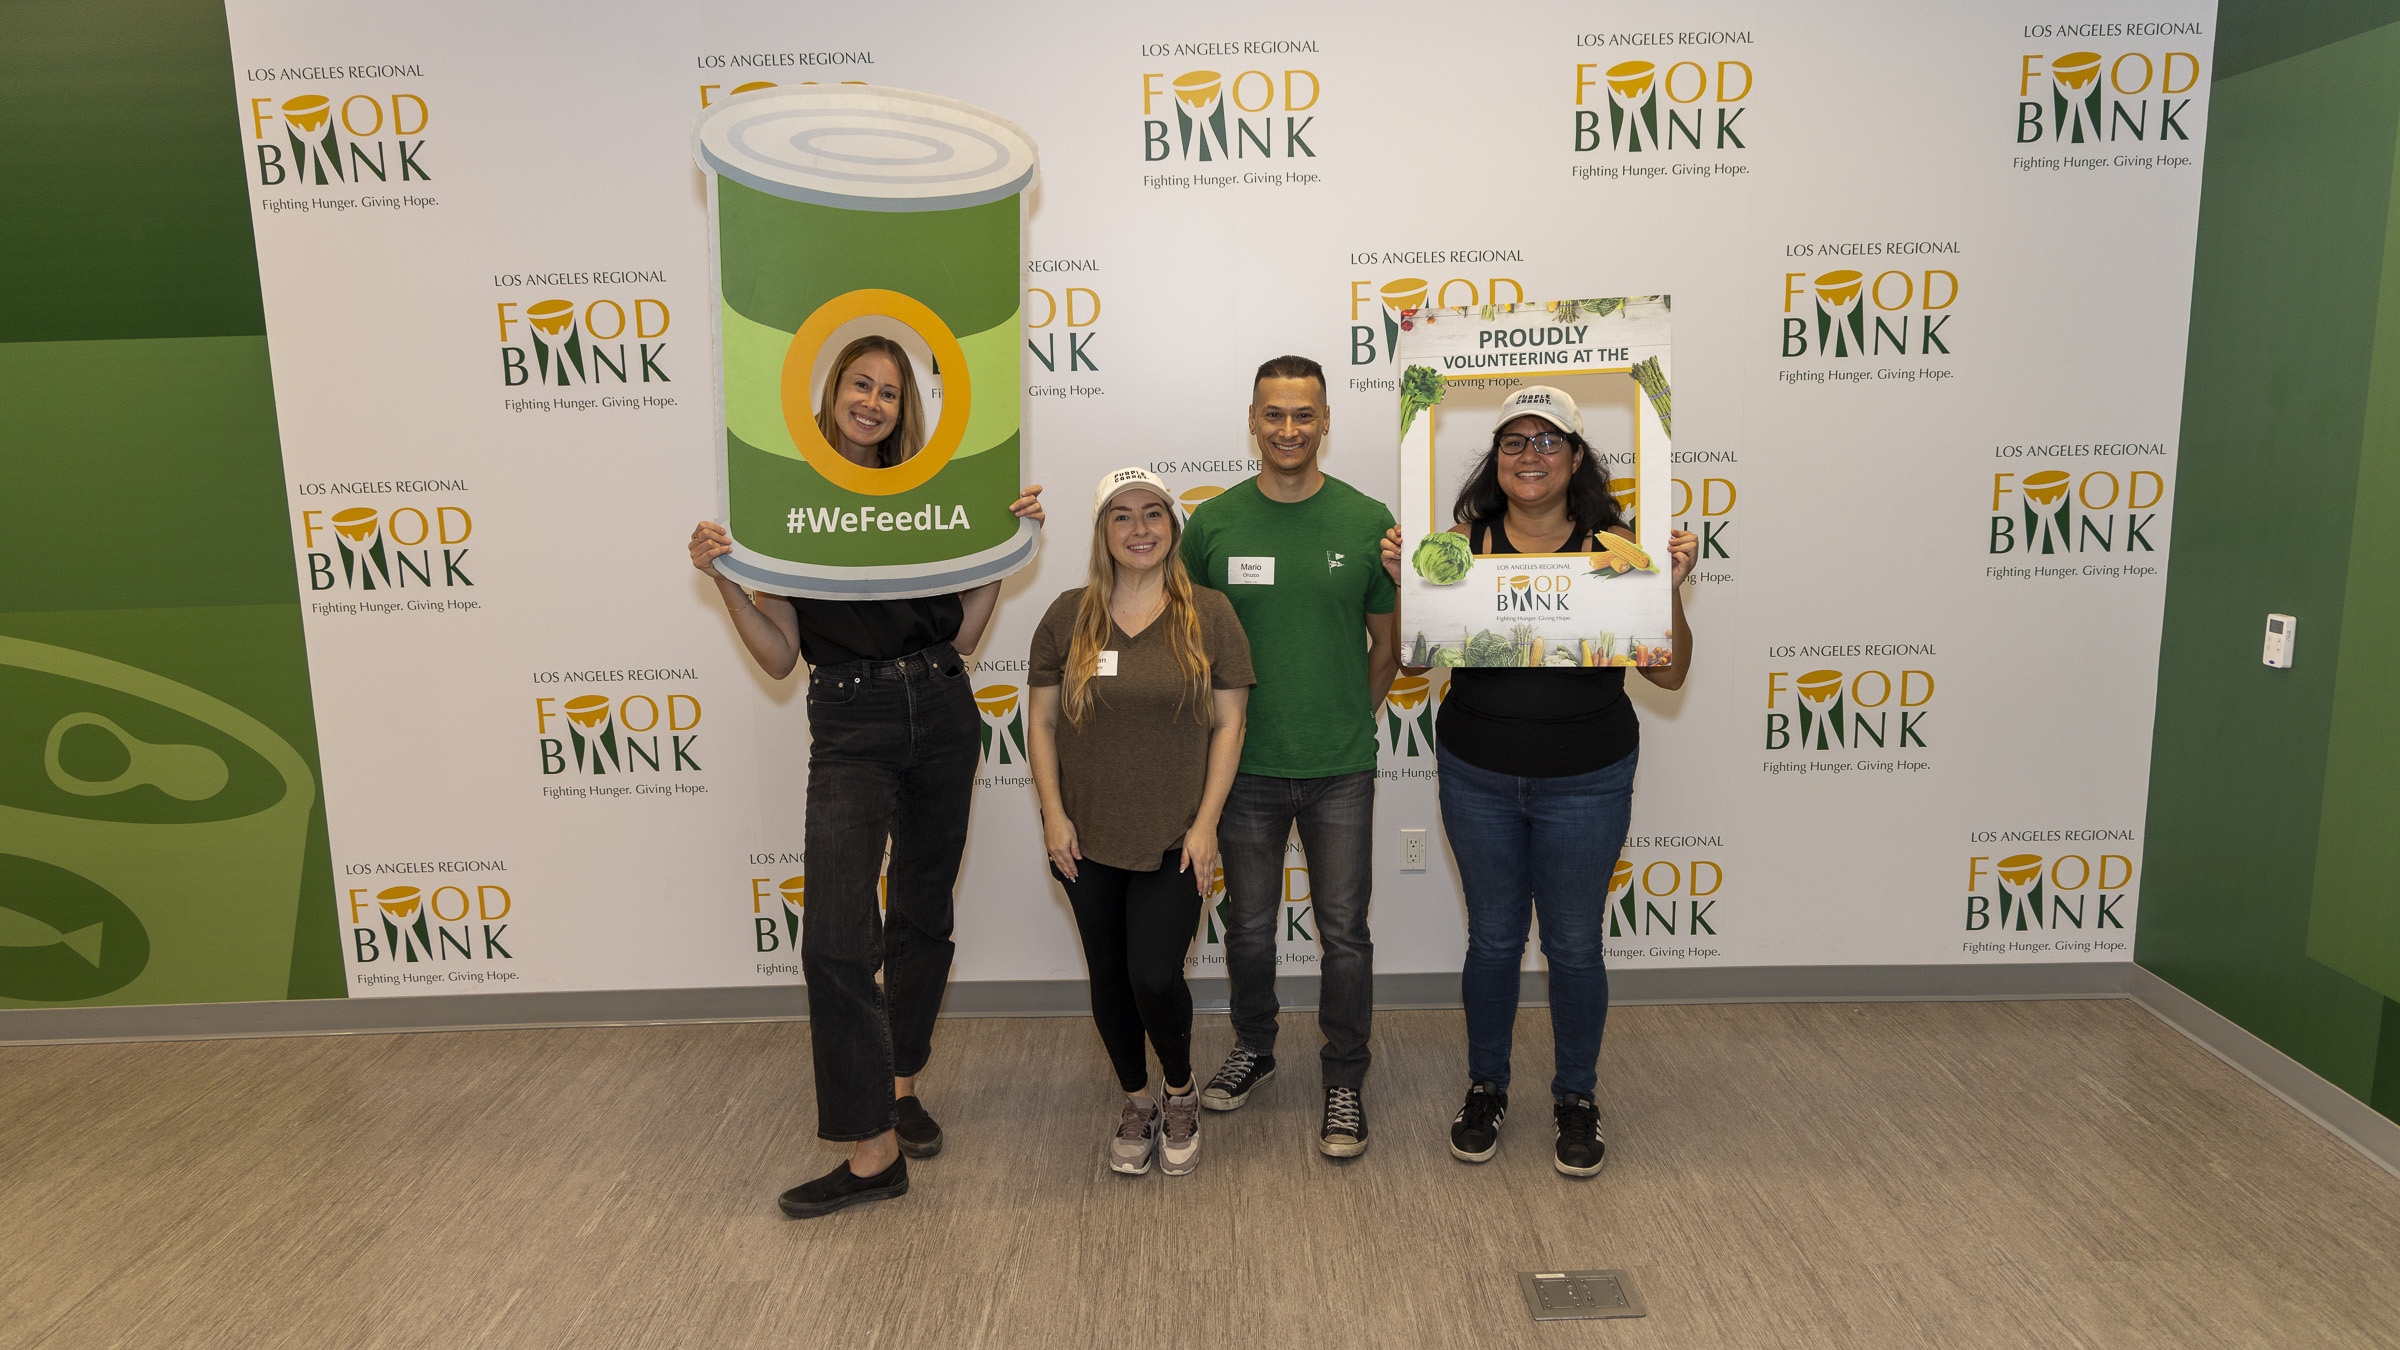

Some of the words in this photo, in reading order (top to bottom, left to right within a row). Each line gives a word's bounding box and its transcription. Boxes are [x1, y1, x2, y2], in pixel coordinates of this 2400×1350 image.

[2024, 24, 2052, 38] LOS
[2056, 23, 2122, 37] ANGELES
[2126, 22, 2202, 36] REGIONAL
[1577, 34, 1605, 47] LOS
[1608, 32, 1674, 46] ANGELES
[1678, 31, 1754, 45] REGIONAL
[1142, 44, 1170, 56] LOS
[1174, 42, 1239, 56] ANGELES
[1244, 40, 1319, 54] REGIONAL
[698, 55, 726, 68] LOS
[730, 53, 795, 67] ANGELES
[799, 51, 875, 65] REGIONAL
[248, 68, 276, 82] LOS
[280, 66, 344, 80] ANGELES
[348, 64, 424, 78] REGIONAL
[2013, 156, 2060, 172] Fighting
[2064, 156, 2109, 170] Hunger.
[2114, 155, 2153, 170] Giving
[2156, 154, 2192, 169] Hope.
[1572, 165, 1618, 180] Fighting
[1622, 165, 1668, 179] Hunger.
[1672, 163, 1711, 178] Giving
[1714, 163, 1750, 177] Hope.
[1144, 174, 1190, 190] Fighting
[1194, 174, 1239, 188] Hunger.
[1243, 172, 1282, 186] Giving
[1286, 172, 1321, 186] Hope.
[262, 198, 310, 214] Fighting
[312, 198, 358, 212] Hunger.
[361, 196, 401, 210] Giving
[403, 195, 439, 209] Hope.
[1351, 253, 1377, 265] LOS
[1382, 251, 1446, 265] ANGELES
[1450, 249, 1524, 263] REGIONAL
[1786, 244, 1814, 257] LOS
[1818, 242, 1882, 256] ANGELES
[1886, 242, 1960, 254] REGIONAL
[494, 274, 522, 287] LOS
[526, 272, 589, 286] ANGELES
[593, 270, 667, 284] REGIONAL
[1479, 325, 1589, 349] PROUDLY
[1443, 351, 1568, 370] VOLUNTEERING
[1573, 349, 1594, 363] AT
[1597, 347, 1629, 362] THE
[1779, 370, 1825, 384] Fighting
[1828, 370, 1873, 384] Hunger.
[1877, 368, 1916, 382] Giving
[1919, 368, 1954, 382] Hope.
[1029, 385, 1067, 399] Giving
[1070, 385, 1104, 399] Hope.
[1349, 377, 1395, 393] Fighting
[1447, 378, 1485, 392] Giving
[1489, 378, 1523, 391] Hope.
[505, 398, 551, 413] Fighting
[553, 398, 598, 412] Hunger.
[602, 396, 640, 410] Giving
[643, 396, 678, 409] Hope.
[1996, 445, 2022, 458] LOS
[2026, 444, 2090, 457] ANGELES
[2094, 444, 2166, 456] REGIONAL
[1150, 462, 1177, 474] LOS
[1181, 460, 1243, 473] ANGELES
[299, 483, 326, 496] LOS
[330, 481, 392, 494] ANGELES
[396, 480, 468, 492] REGIONAL
[787, 503, 970, 534] #WeFeedLA
[1240, 563, 1262, 571] Mario
[1986, 566, 2031, 580] Fighting
[2034, 566, 2078, 580] Hunger.
[2082, 565, 2120, 578] Giving
[2123, 565, 2157, 578] Hope.
[1700, 572, 1734, 585] Hope.
[312, 602, 357, 616] Fighting
[360, 602, 404, 614] Hunger.
[407, 600, 445, 613] Giving
[447, 599, 481, 612] Hope.
[1770, 646, 1796, 658] LOS
[1799, 644, 1861, 657] ANGELES
[1865, 644, 1936, 656] REGIONAL
[533, 672, 560, 684] LOS
[563, 670, 624, 682] ANGELES
[628, 668, 698, 681] REGIONAL
[1763, 761, 1807, 775] Fighting
[1810, 761, 1853, 774] Hunger.
[1857, 760, 1894, 774] Giving
[1897, 760, 1930, 772] Hope.
[543, 786, 587, 800] Fighting
[589, 786, 632, 798] Hunger.
[635, 784, 672, 796] Giving
[675, 784, 708, 796] Hope.
[1654, 836, 1724, 847] REGIONAL
[1971, 831, 1997, 842] LOS
[2000, 830, 2061, 842] ANGELES
[2065, 830, 2134, 841] REGIONAL
[750, 853, 776, 865] LOS
[346, 864, 372, 875] LOS
[375, 862, 435, 874] ANGELES
[438, 860, 508, 872] REGIONAL
[1603, 947, 1646, 959] Hunger.
[1649, 947, 1685, 959] Giving
[1688, 947, 1721, 959] Hope.
[1962, 942, 2006, 954] Fighting
[2009, 942, 2051, 954] Hunger.
[2054, 940, 2091, 953] Giving
[2094, 940, 2127, 952] Hope.
[1286, 953, 1319, 966] Hope.
[756, 963, 799, 976] Fighting
[357, 974, 401, 986] Fighting
[403, 973, 445, 985] Hunger.
[448, 971, 484, 984] Giving
[486, 971, 519, 982] Hope.
